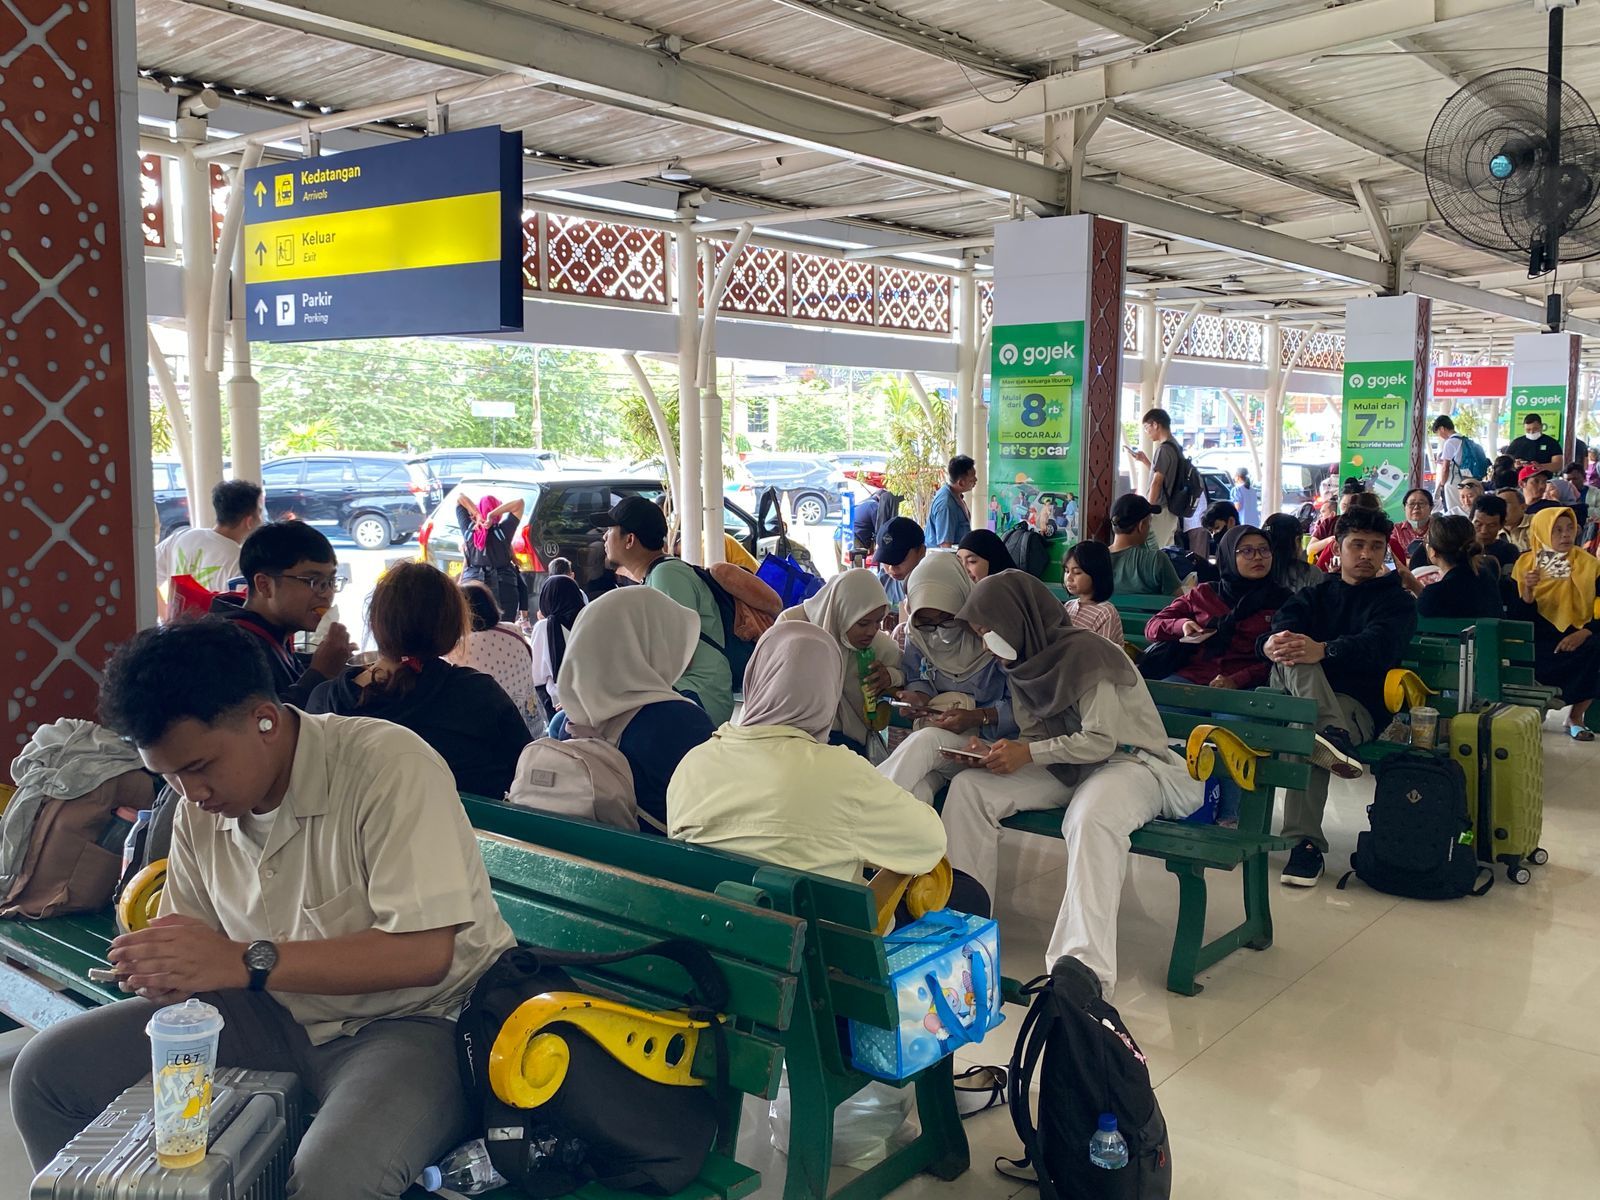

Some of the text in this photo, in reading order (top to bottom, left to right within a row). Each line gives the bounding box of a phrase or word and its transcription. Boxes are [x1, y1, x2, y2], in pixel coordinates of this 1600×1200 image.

[301, 165, 361, 185] Kedatangan
[303, 190, 328, 201] Arrivals
[302, 230, 336, 246] Keluar
[303, 252, 317, 263] Exit
[302, 291, 333, 307] Parkir
[282, 301, 290, 320] P
[303, 313, 329, 325] Parking
[1023, 341, 1076, 365] gojek
[1437, 370, 1472, 378] Dilarang
[1367, 372, 1407, 389] gojek
[1002, 393, 1022, 401] Mulai
[1530, 395, 1562, 406] gojek
[1021, 393, 1060, 427] 8 rb
[1353, 402, 1400, 410] Mulai dari
[1014, 431, 1063, 439] GOCARAJA
[999, 444, 1070, 458] let's gocar
[546, 543, 557, 554] 03
